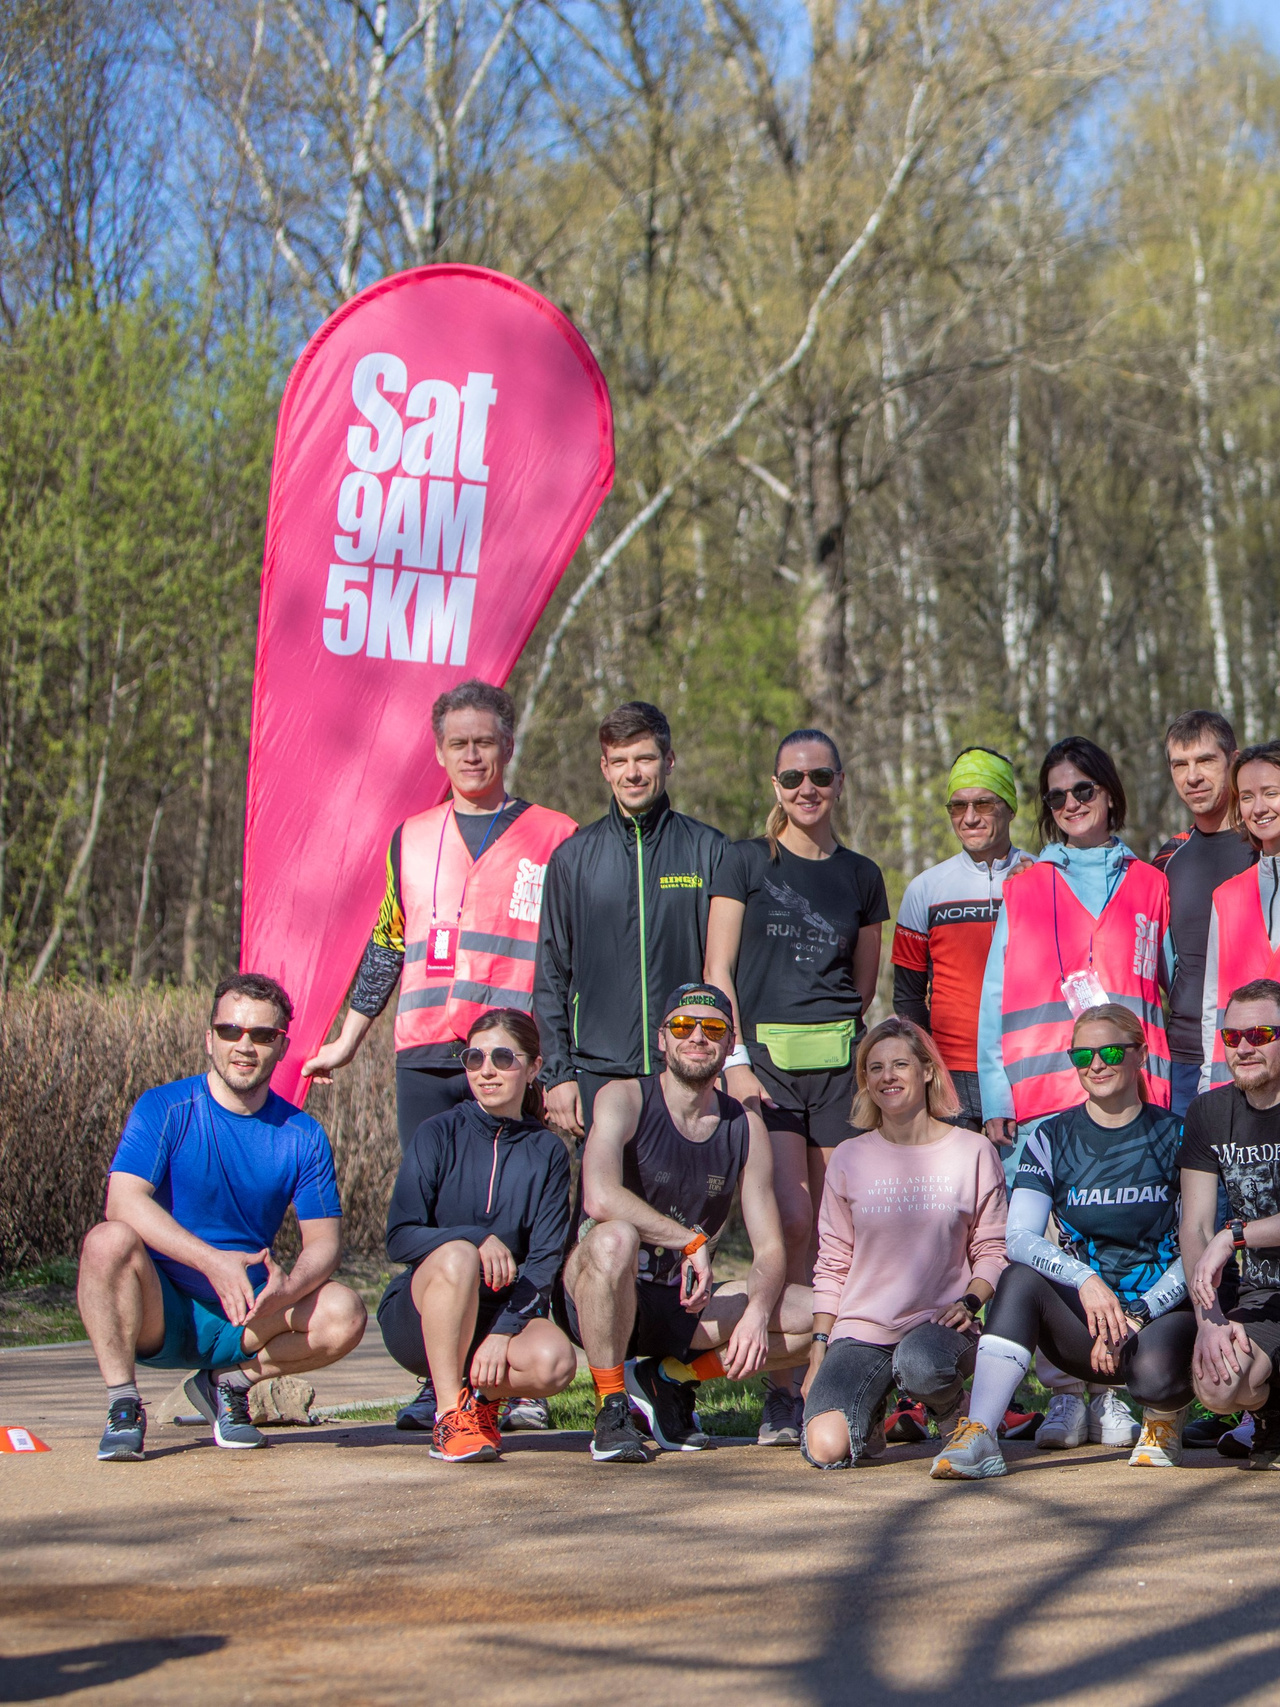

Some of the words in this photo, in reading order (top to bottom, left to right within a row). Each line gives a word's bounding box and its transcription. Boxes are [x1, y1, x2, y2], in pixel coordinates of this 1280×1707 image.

[347, 351, 498, 482] Sat
[334, 471, 487, 575] 9AM
[322, 563, 477, 667] 5KM
[516, 857, 548, 885] Sat
[766, 923, 801, 938] RUN
[806, 928, 848, 949] CLUB
[1135, 912, 1160, 944] Sat
[790, 942, 824, 954] MOSCOW
[867, 1187, 897, 1196] WITH
[874, 1178, 902, 1187] FALL
[906, 1175, 951, 1185] ASLEEP
[885, 1194, 918, 1204] WAKE
[923, 1193, 937, 1201] UP
[1066, 1185, 1169, 1207] MALIDAK
[861, 1205, 891, 1215] WITH
[896, 1205, 903, 1213] A
